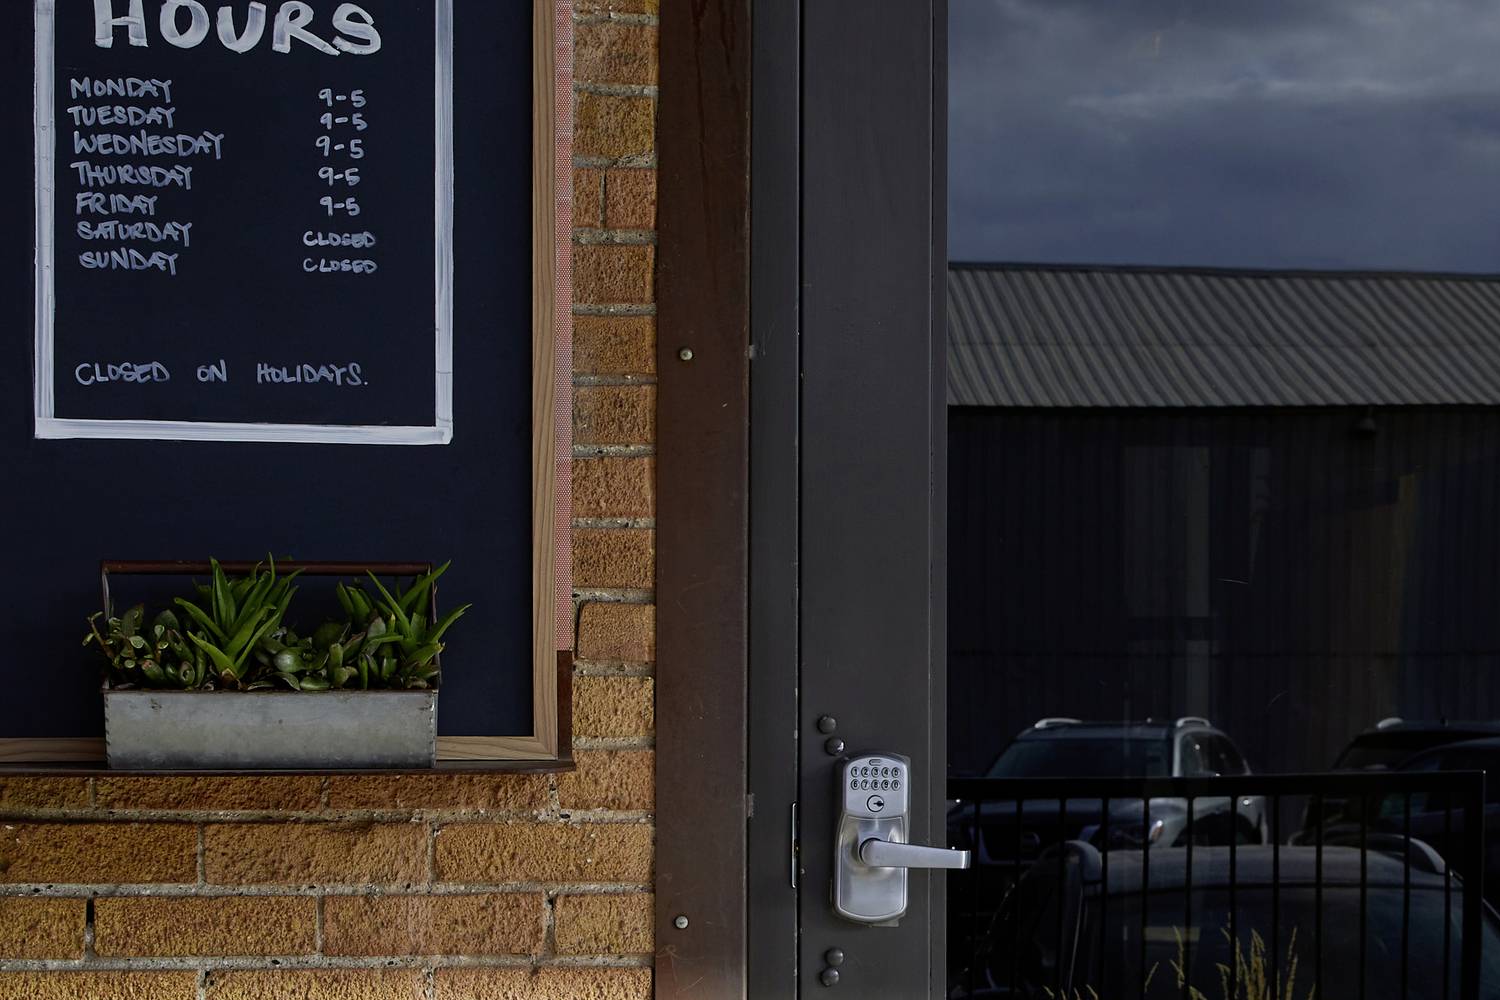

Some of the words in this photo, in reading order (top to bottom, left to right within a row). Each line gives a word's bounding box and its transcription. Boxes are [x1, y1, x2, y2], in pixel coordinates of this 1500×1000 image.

[94, 0, 382, 56] HOURS
[70, 77, 172, 103] MONDAY
[318, 88, 366, 108] 9-5
[67, 105, 176, 128] TUESDAY
[319, 112, 368, 131] 9-5
[74, 130, 225, 160] WEDNESDAY
[315, 136, 365, 159] 9-5
[70, 161, 193, 190] THURSDAY
[317, 166, 361, 187] 9-5
[75, 192, 158, 216] FRIDAY
[319, 196, 361, 217] 9-5
[76, 221, 193, 247] SATURDAY
[302, 231, 376, 249] CLOSED
[78, 248, 179, 275] SUNDAY
[302, 258, 378, 274] CLOSED
[75, 361, 171, 386] CLOSED
[196, 359, 228, 384] ON
